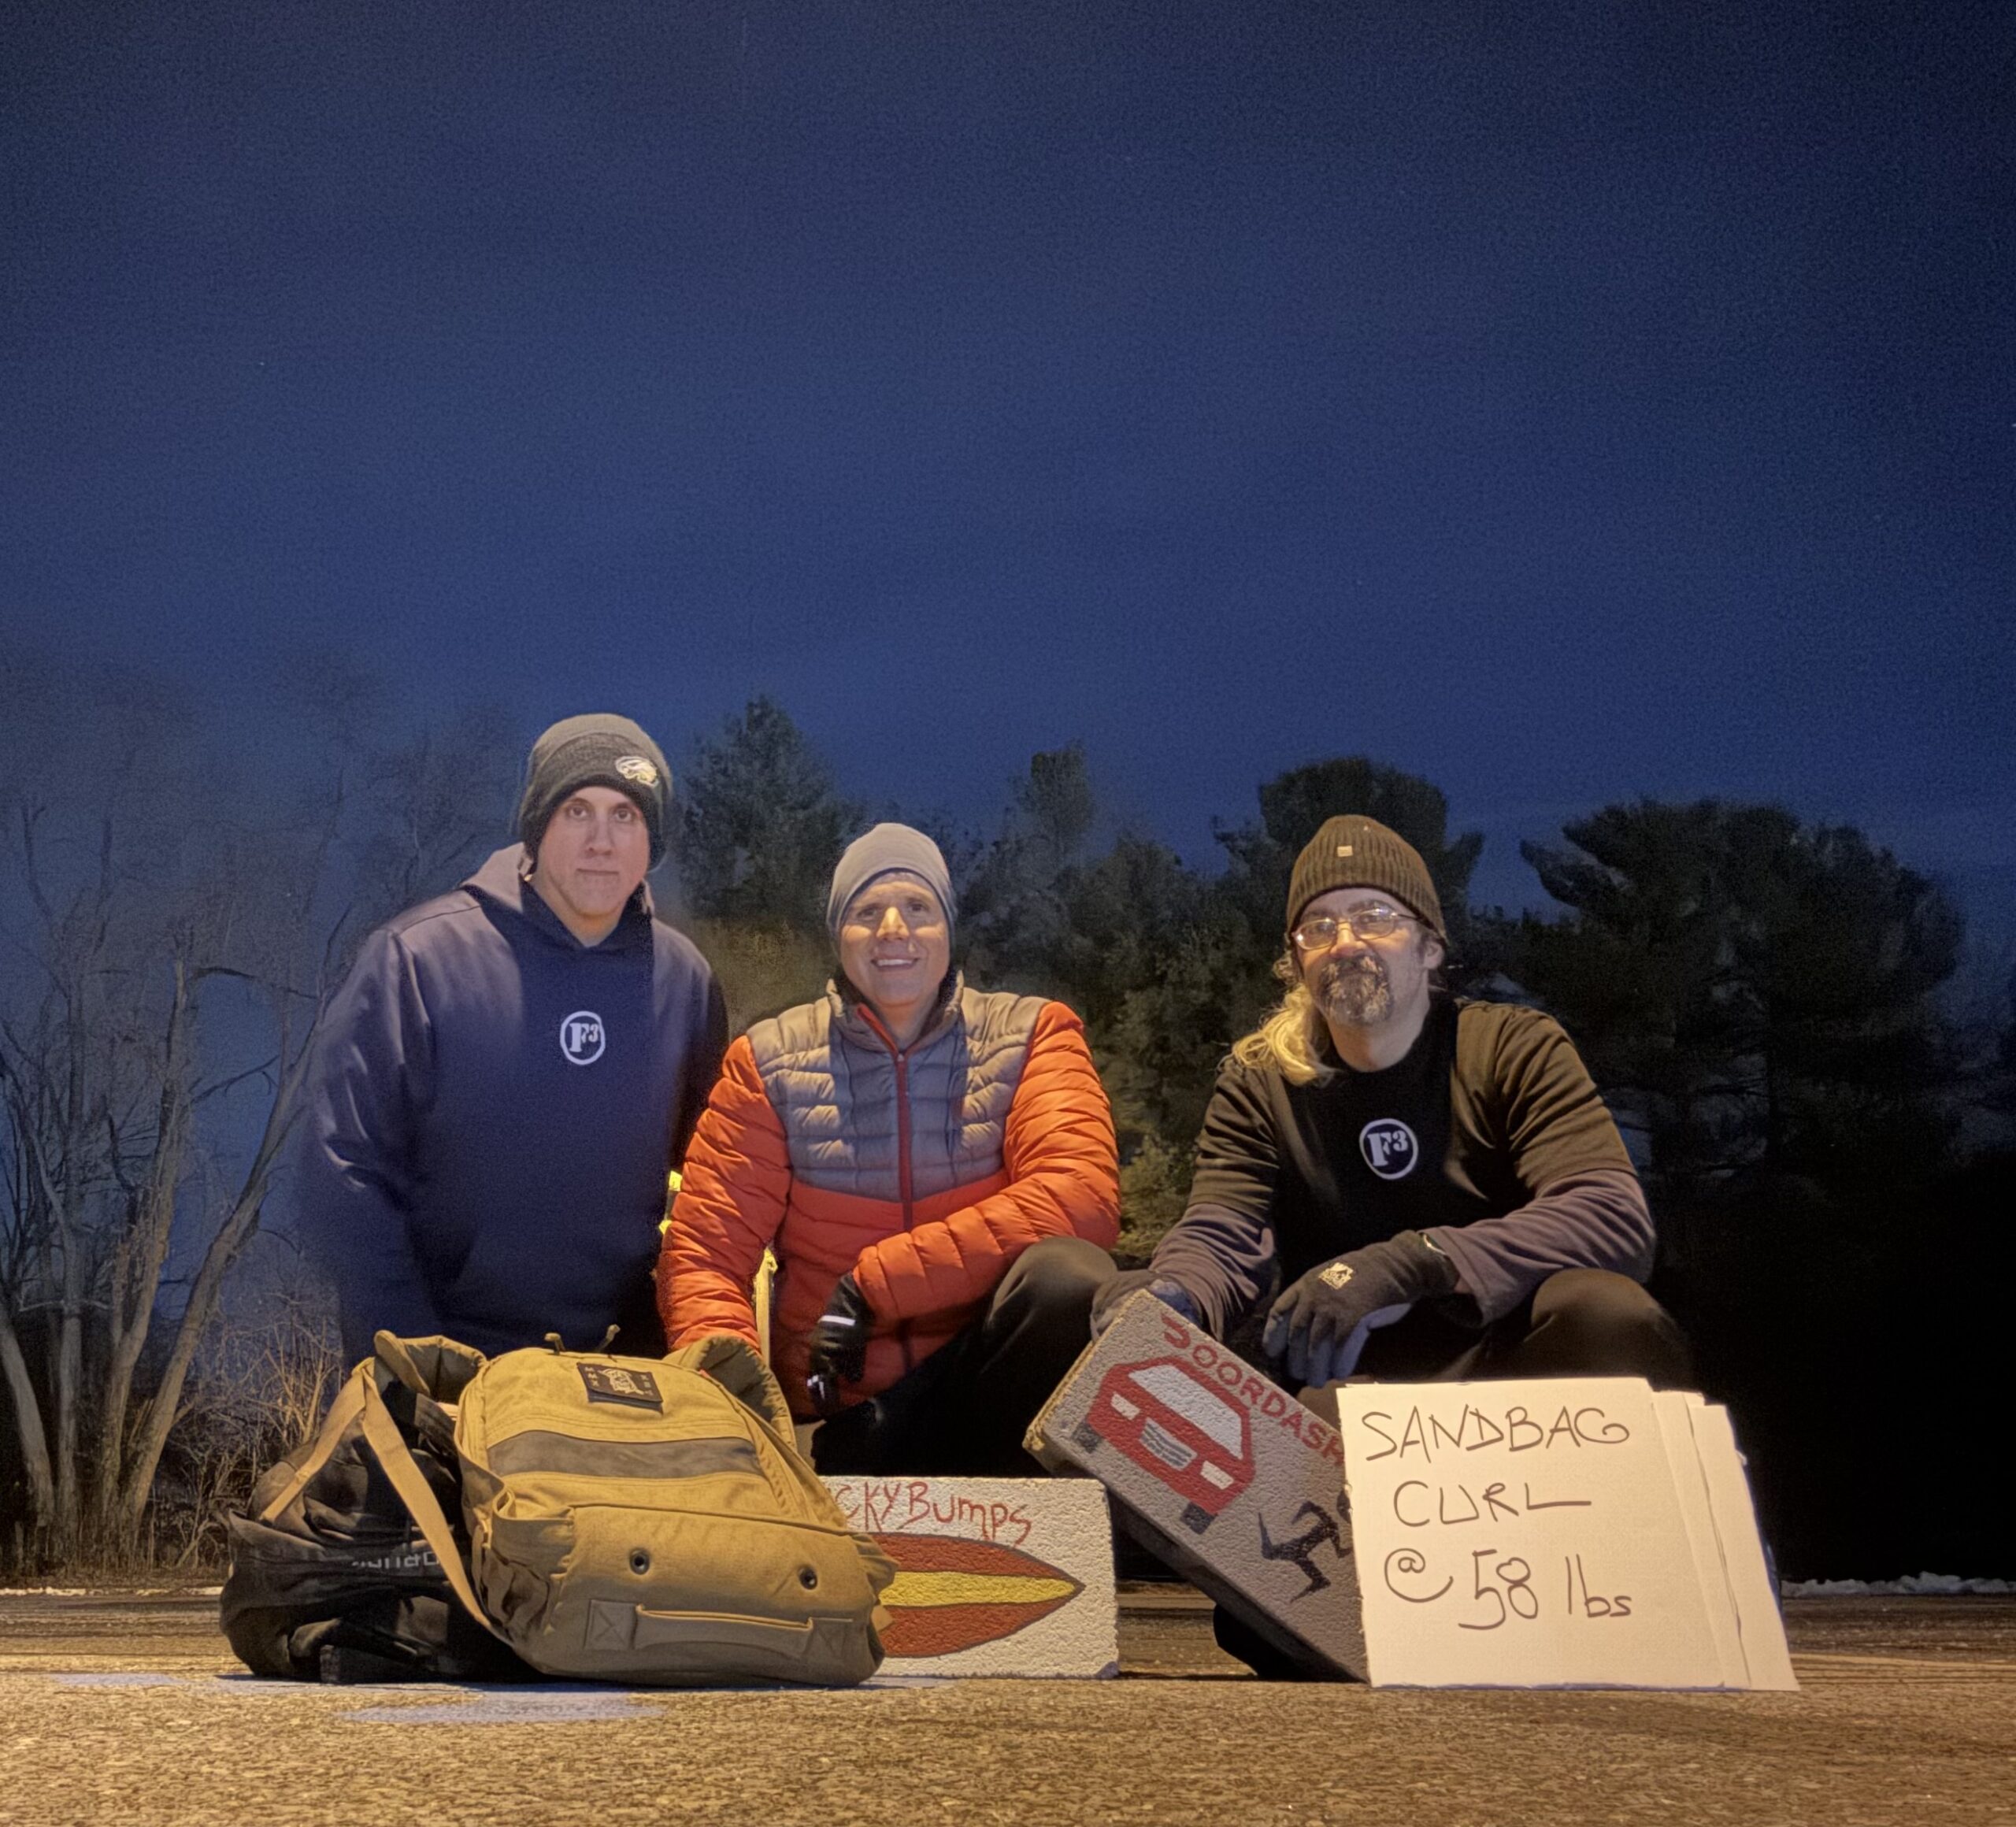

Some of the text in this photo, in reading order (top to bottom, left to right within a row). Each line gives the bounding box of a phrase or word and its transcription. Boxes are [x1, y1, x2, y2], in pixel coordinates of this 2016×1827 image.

[569, 1023, 598, 1052] F3
[1367, 1130, 1408, 1166] F3
[1362, 1404, 1629, 1463] SANDBAG
[1394, 1480, 1592, 1527] CURL
[1384, 1548, 1631, 1629] @ 58 lbs
